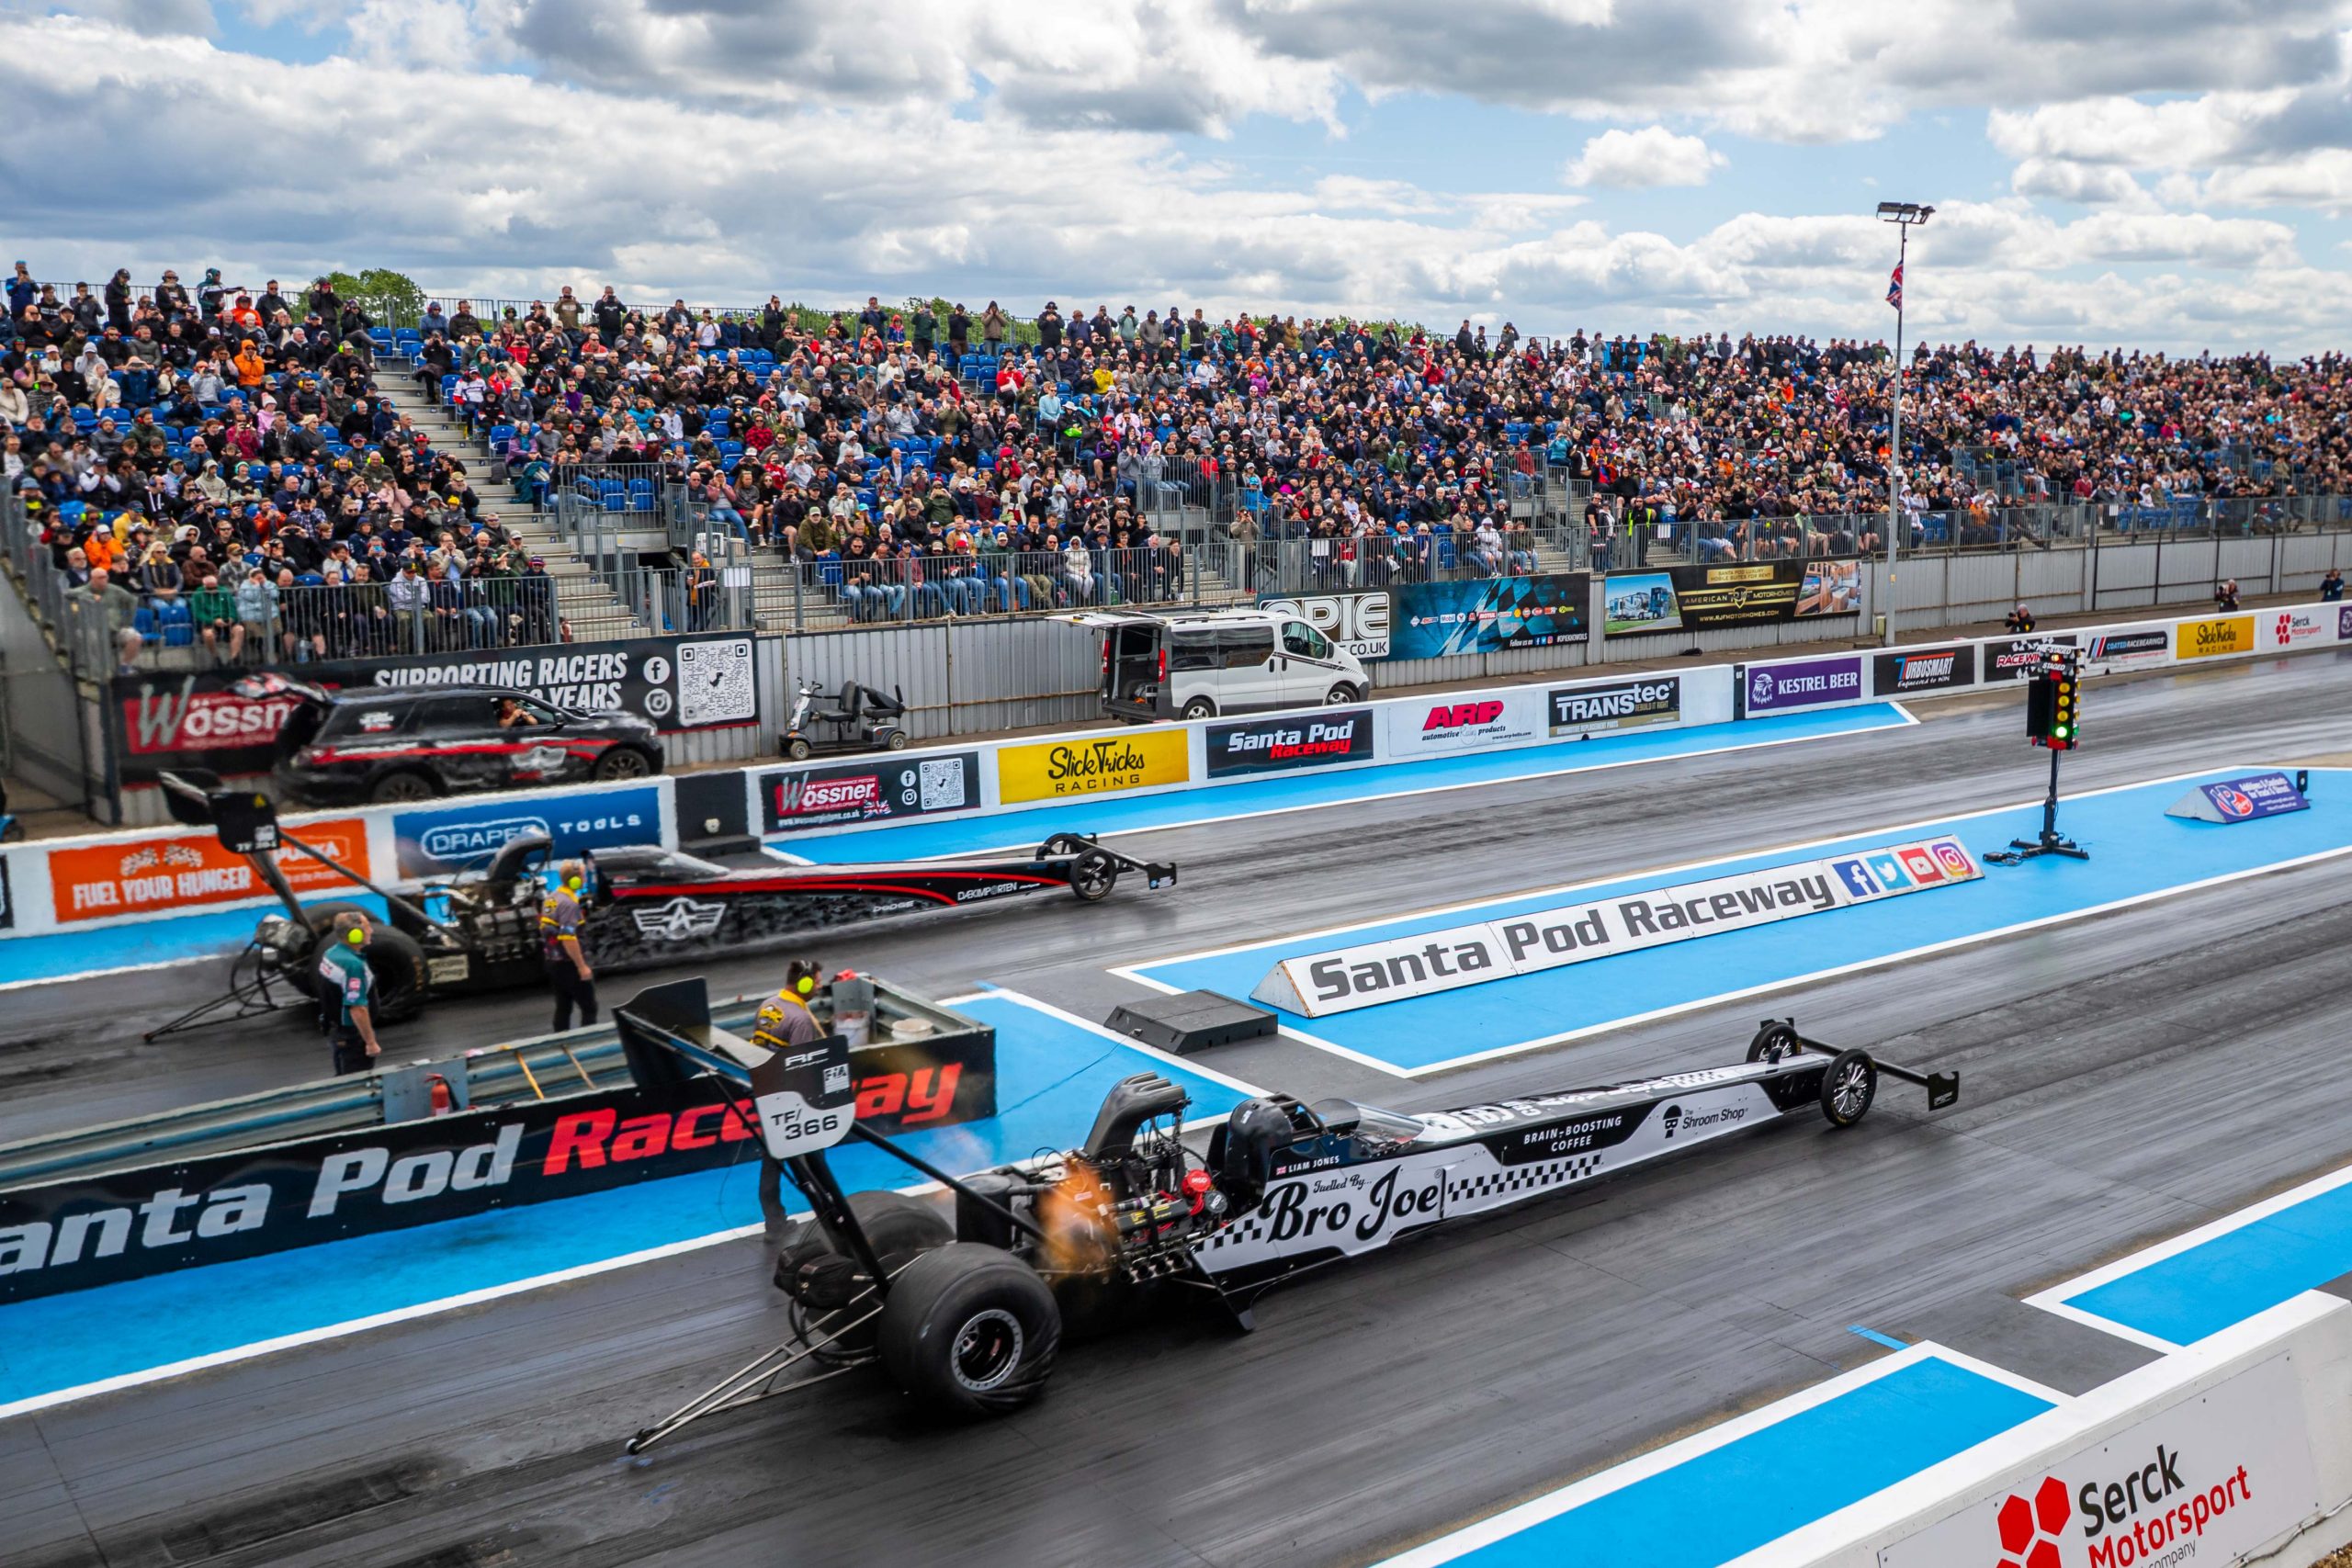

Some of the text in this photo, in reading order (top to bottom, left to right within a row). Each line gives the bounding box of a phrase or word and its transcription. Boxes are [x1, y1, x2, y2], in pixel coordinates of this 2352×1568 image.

[1685, 595, 1727, 604] AMERICAN
[1753, 590, 1795, 599] MOTORHOMES
[2291, 615, 2311, 626] Serck
[2291, 626, 2322, 637] Motorsport
[2199, 645, 2234, 653] RACING
[375, 652, 629, 688] SUPPORTING RACERS
[1894, 652, 1955, 682] TURBOSMART
[2042, 662, 2066, 671] STAGED
[1778, 671, 1858, 695] KESTREL BEER
[549, 682, 623, 710] YEARS
[139, 675, 300, 747] Wössn
[1422, 700, 1504, 731] ARP
[1227, 720, 1354, 752] Santa Pod
[1422, 730, 1460, 740] automotive
[1477, 725, 1506, 736] products
[1270, 739, 1352, 760] Raceway
[1056, 774, 1140, 793] RACING
[560, 815, 642, 834] TOOLS
[73, 881, 119, 909] FUEL
[120, 874, 174, 903] YOUR
[178, 865, 252, 897] HUNGER
[874, 900, 914, 912] DODGE
[1310, 874, 1836, 1002] Santa Pod Raceway
[771, 1108, 802, 1125] TF/
[785, 1114, 838, 1140] 366
[1682, 1108, 1745, 1130] Shroom Shop
[1523, 1115, 1623, 1145] BRAIN-BOOSTING
[1551, 1134, 1593, 1152] COFFEE
[0, 1062, 963, 1274] anta Pod Raceay
[1288, 1155, 1340, 1174] LIAM JONES
[1313, 1179, 1347, 1194] Fuelled
[1258, 1164, 1439, 1244] Bro Joe
[2079, 1444, 2186, 1538] Serck
[2087, 1464, 2251, 1568] Motorsport
